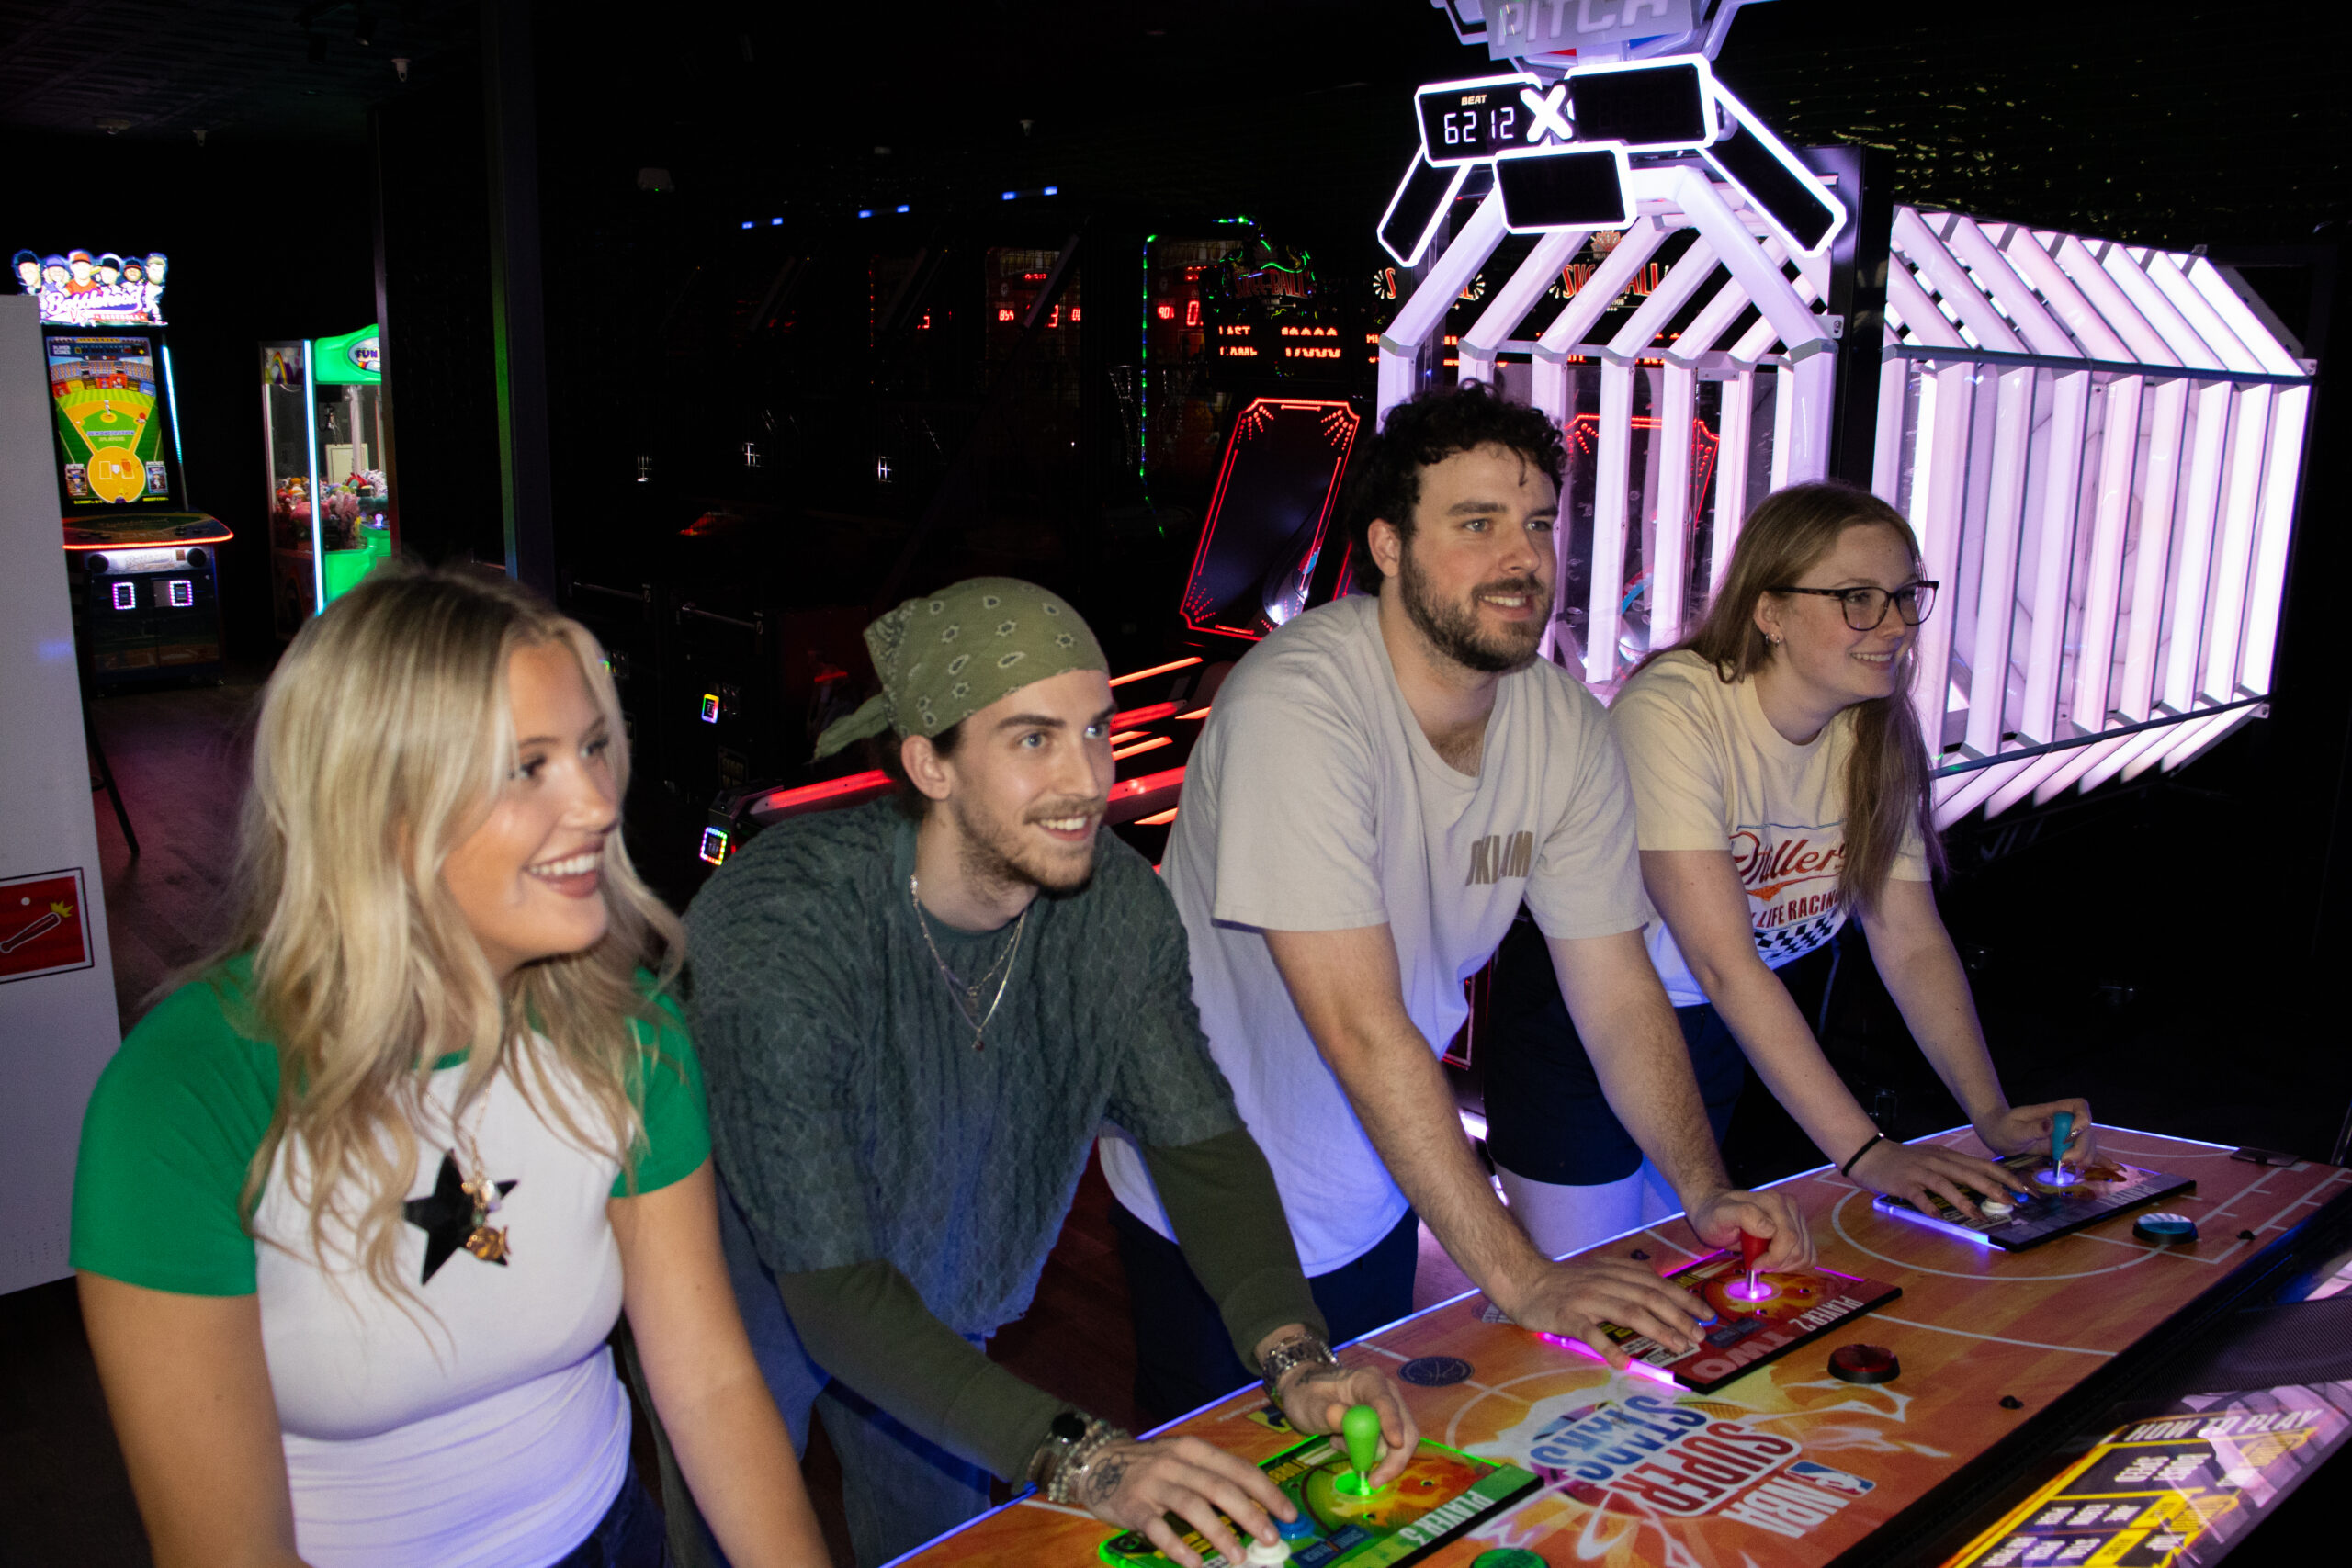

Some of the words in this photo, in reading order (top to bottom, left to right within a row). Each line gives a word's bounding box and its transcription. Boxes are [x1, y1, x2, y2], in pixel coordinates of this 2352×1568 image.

[1461, 94, 1487, 106] BEAT
[1443, 107, 1514, 144] 6212
[46, 284, 145, 314] Bobblehead
[1757, 906, 1785, 928] LIFE
[1788, 889, 1838, 921] RACIN
[1788, 1317, 1817, 1332] 2
[1800, 1295, 1865, 1326] PLAYER
[1530, 1395, 1707, 1481] STARS
[2124, 1419, 2201, 1442] HOW
[2237, 1409, 2324, 1434] PLAY
[1608, 1422, 1794, 1513] SUPER
[1414, 1489, 1496, 1539] PLAYER
[1718, 1472, 1850, 1540] NBA
[1397, 1526, 1430, 1546] 3
